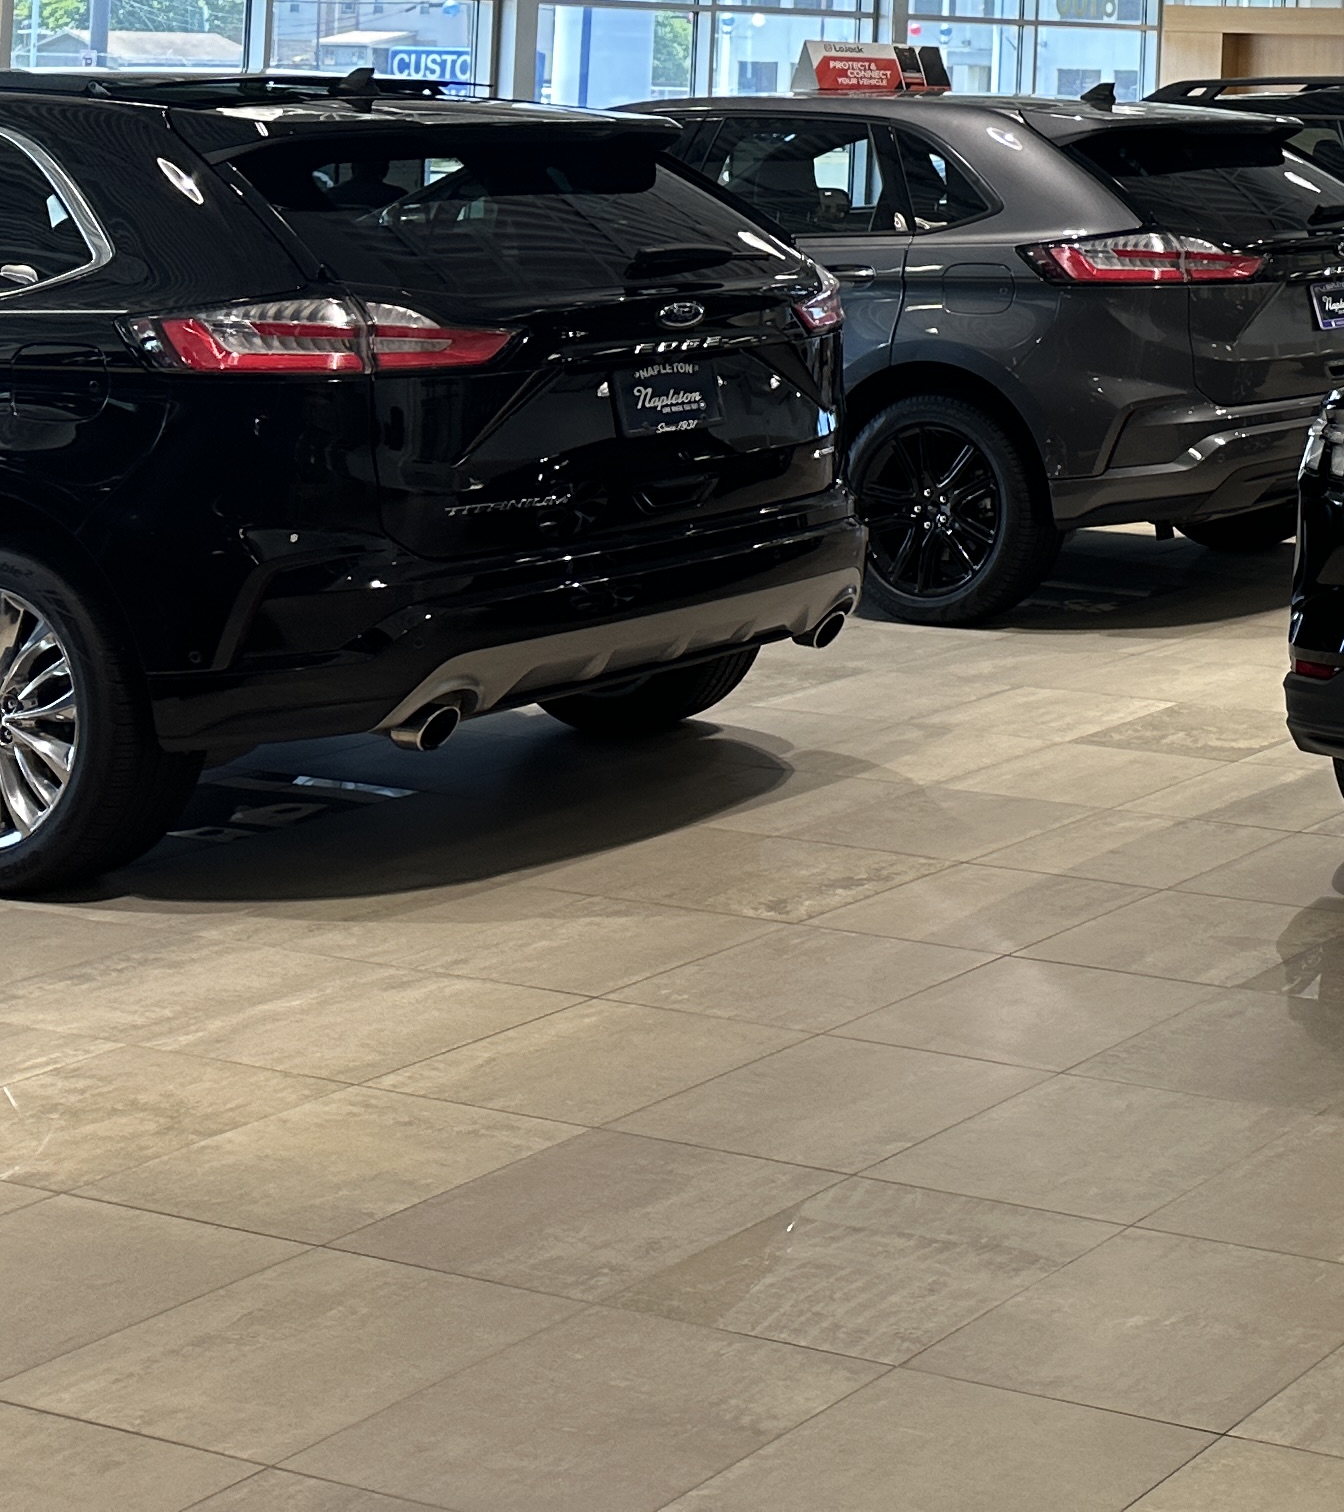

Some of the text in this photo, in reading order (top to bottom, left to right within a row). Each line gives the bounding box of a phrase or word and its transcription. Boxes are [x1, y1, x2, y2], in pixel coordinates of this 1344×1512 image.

[830, 60, 869, 70] PROTECT
[848, 69, 892, 80] CONNECT
[837, 77, 888, 86] YOUR VEHICLE
[634, 336, 721, 354] EDGE
[640, 363, 693, 379] NAPLETON
[633, 386, 702, 411] Napleton
